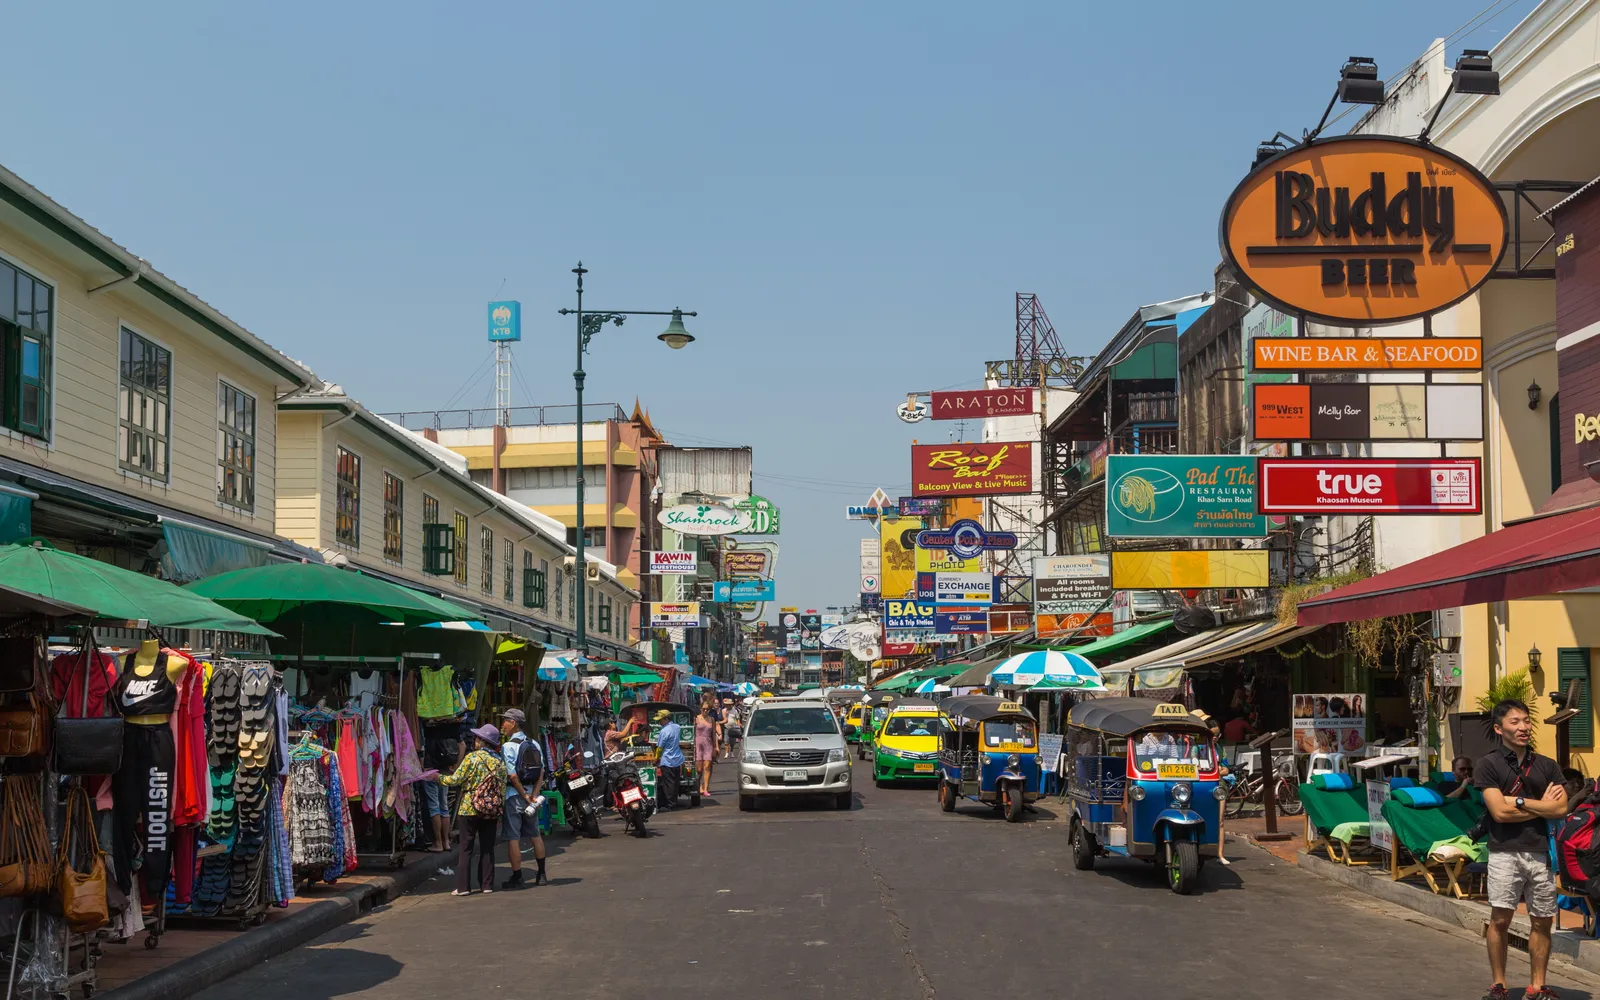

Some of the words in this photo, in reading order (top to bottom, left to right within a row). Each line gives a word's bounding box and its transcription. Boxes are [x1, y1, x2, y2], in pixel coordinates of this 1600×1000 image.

[1275, 171, 1454, 254] Buddy
[1321, 259, 1417, 286] BEER
[493, 328, 511, 336] KTB
[1259, 346, 1312, 361] WINE
[1316, 346, 1362, 361] BAR
[1364, 346, 1379, 361] &
[1385, 346, 1478, 361] SEAFOOD
[940, 394, 1025, 410] ARATON
[1276, 405, 1304, 414] WEST
[1318, 405, 1342, 420] Molly
[1344, 405, 1362, 415] Bar
[928, 445, 1009, 471] Roof
[953, 465, 991, 478] Bar
[1186, 465, 1220, 485] Pad
[919, 483, 951, 491] Balcony
[984, 480, 1001, 488] Live
[1004, 479, 1027, 487] Music
[1317, 470, 1382, 494] true
[1317, 496, 1348, 504] Khaosan
[1350, 496, 1382, 504] Museum
[667, 512, 740, 526] Shamrock
[1197, 508, 1253, 520] ร้านผัดไทย
[921, 534, 955, 545] Center
[957, 534, 984, 545] Point
[986, 535, 1013, 546] Plaza
[655, 553, 692, 564] KAWIN
[930, 549, 945, 561] ID
[930, 561, 965, 570] PHOTO
[938, 582, 990, 590] EXCHANGE
[888, 602, 934, 617] BAG
[905, 619, 915, 627] Trip
[126, 680, 158, 695] NIKE
[1160, 705, 1182, 713] TAXI
[149, 767, 168, 808] JUST
[148, 812, 168, 834] DO
